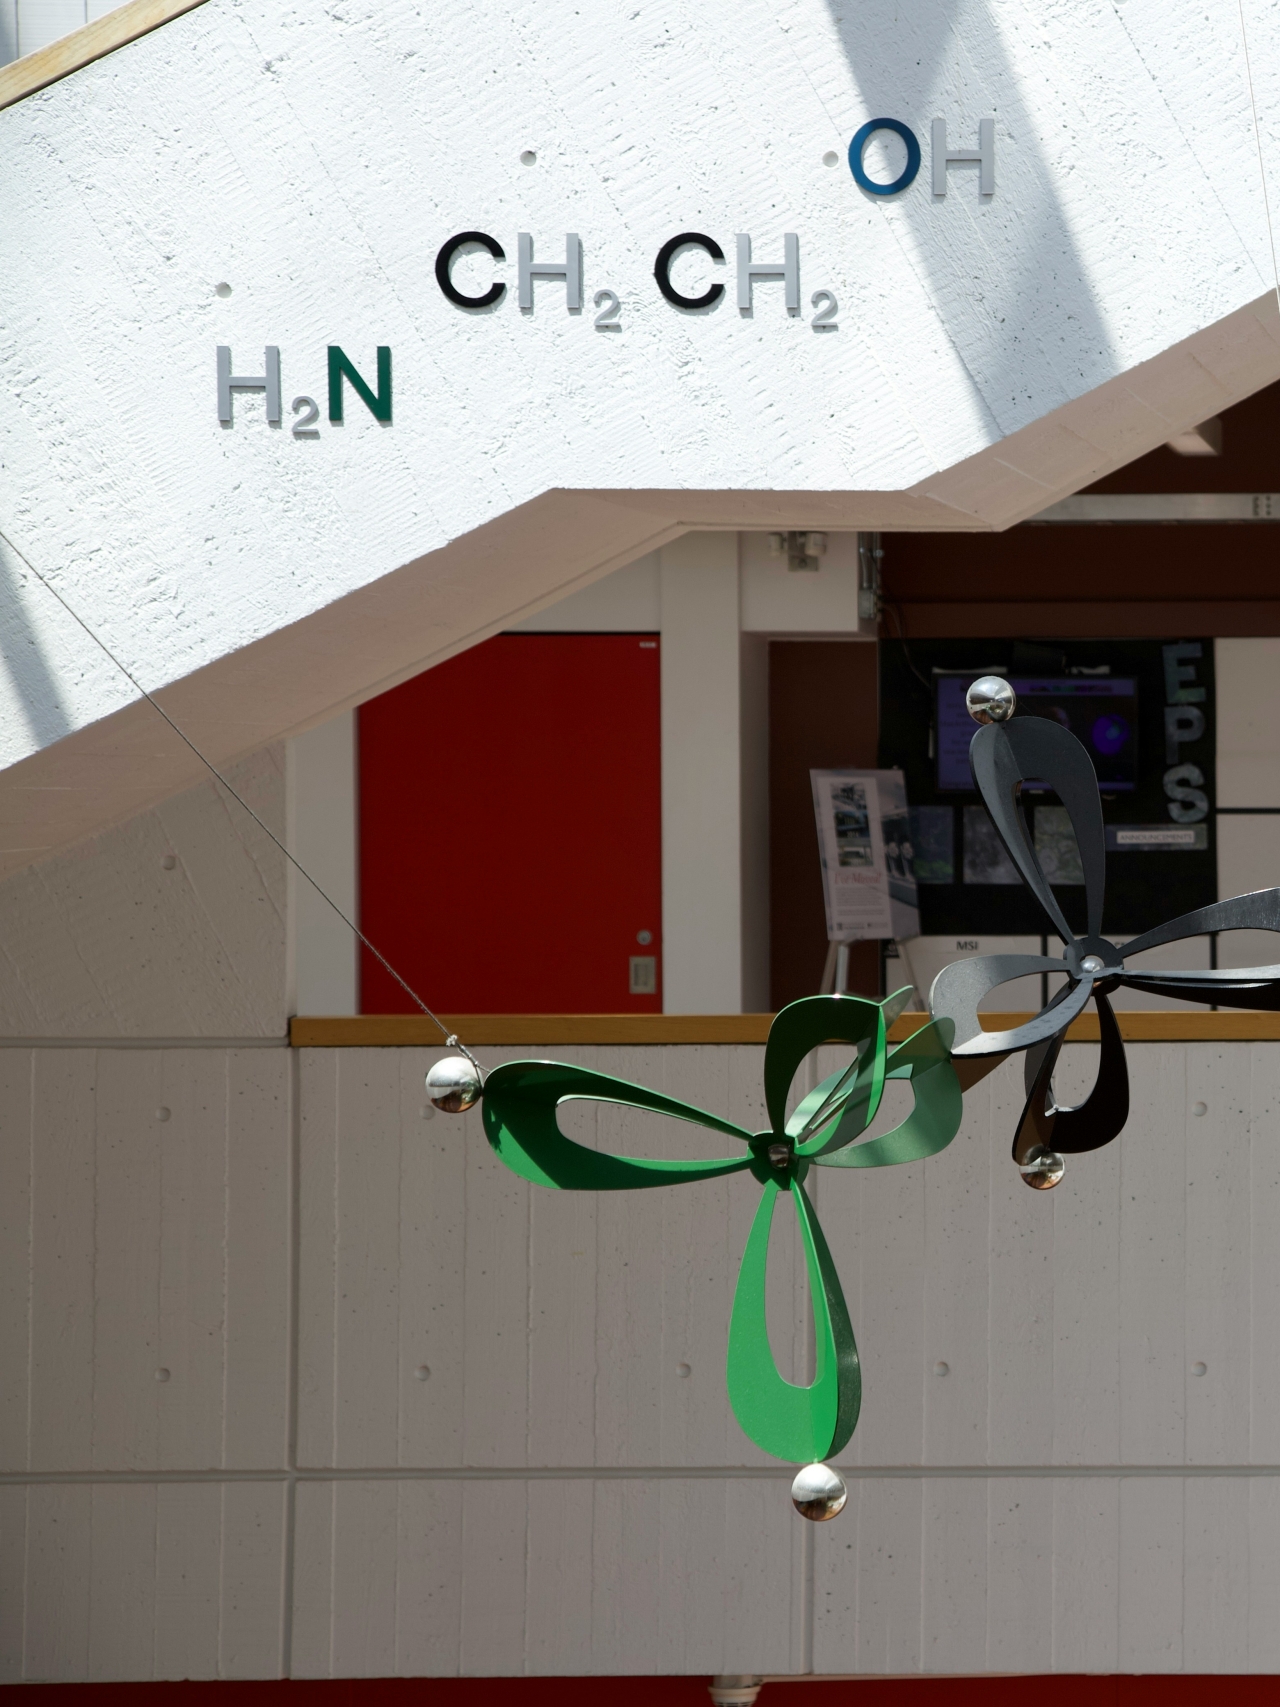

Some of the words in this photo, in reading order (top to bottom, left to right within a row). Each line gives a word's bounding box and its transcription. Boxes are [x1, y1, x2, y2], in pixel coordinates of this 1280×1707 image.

[848, 117, 995, 197] OH
[1162, 641, 1210, 824] EPS
[1120, 832, 1193, 842] ANNOUNCEMENTS
[956, 941, 979, 952] MSI
